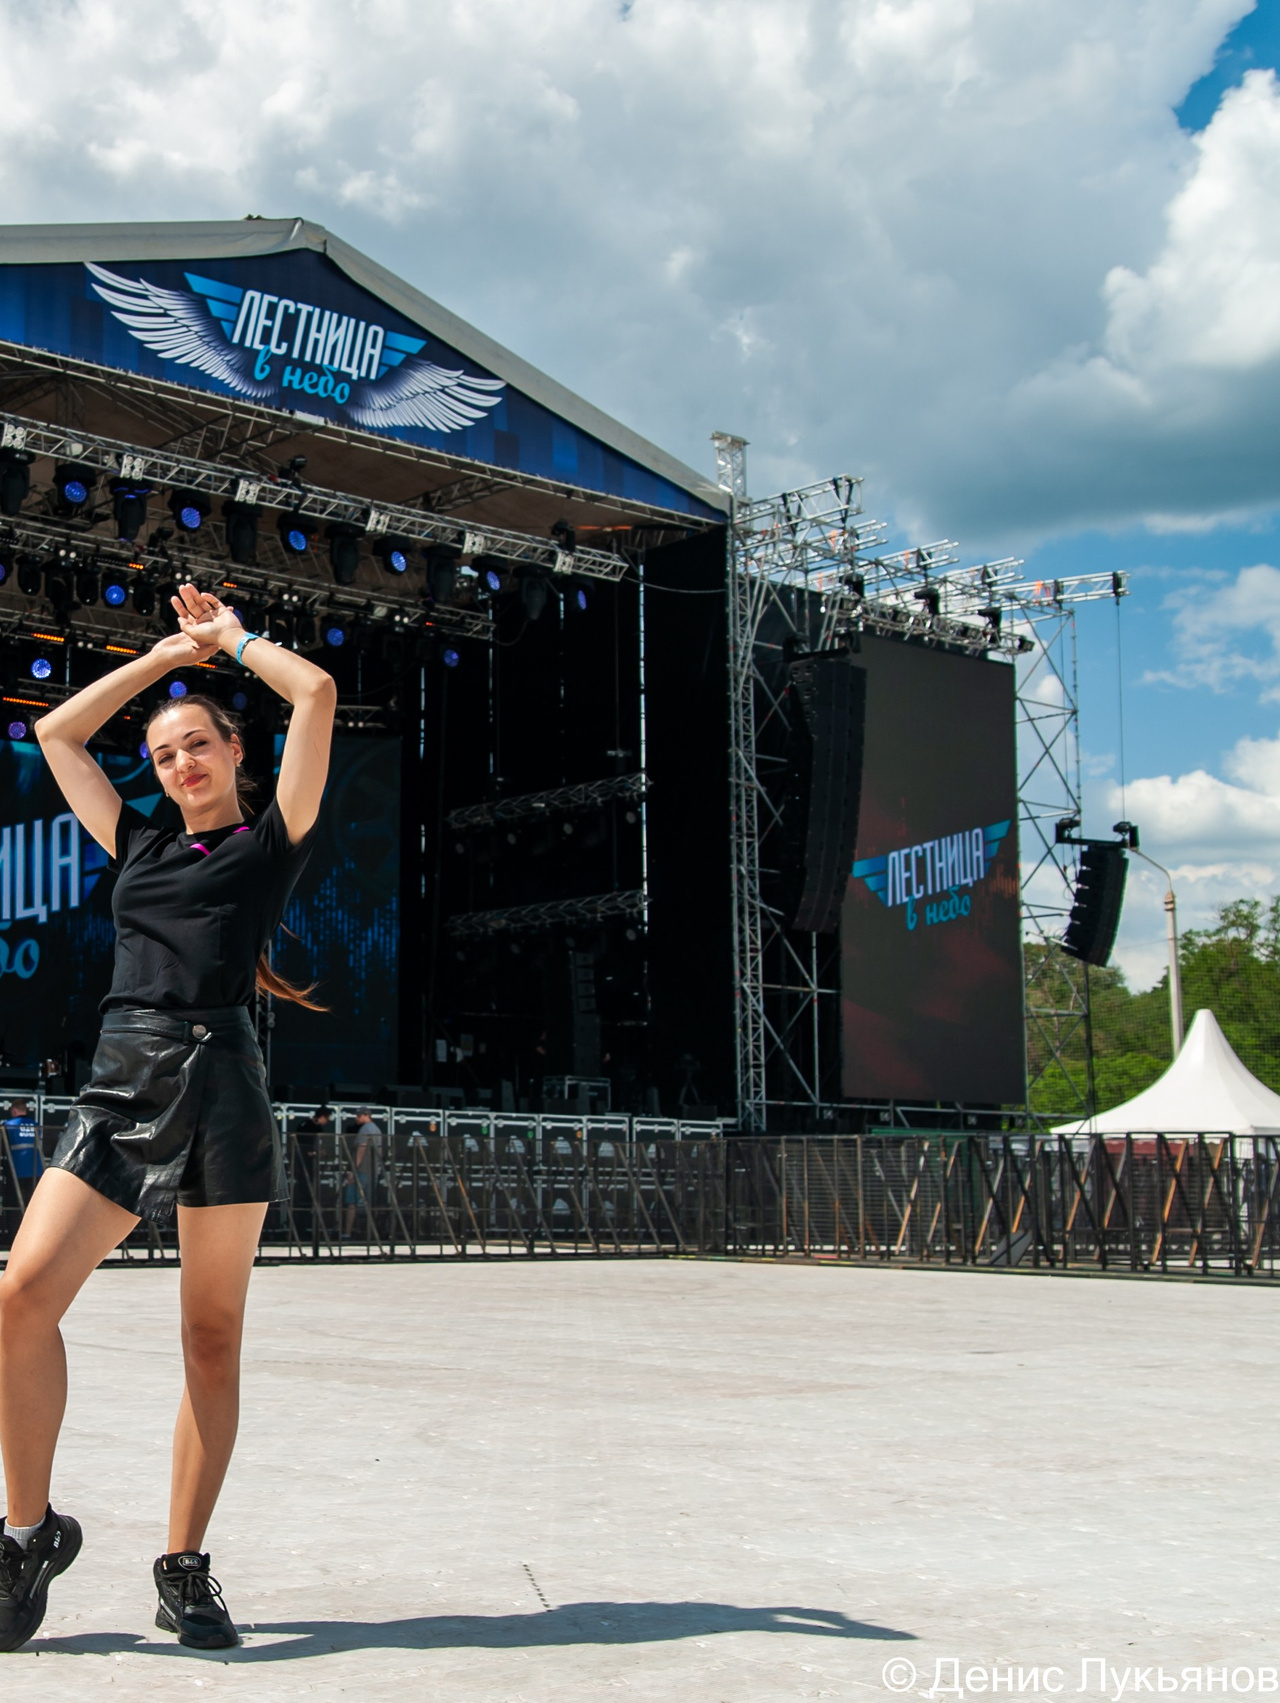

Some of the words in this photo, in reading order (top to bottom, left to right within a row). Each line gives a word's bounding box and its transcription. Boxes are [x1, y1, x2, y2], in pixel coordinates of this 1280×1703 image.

[232, 289, 385, 382] ЛЕСТНИЦА
[253, 345, 273, 382] в
[282, 364, 351, 405] небо
[887, 827, 985, 908] ЛЕСТНИЦА
[906, 896, 918, 931] в
[925, 886, 972, 926] небо
